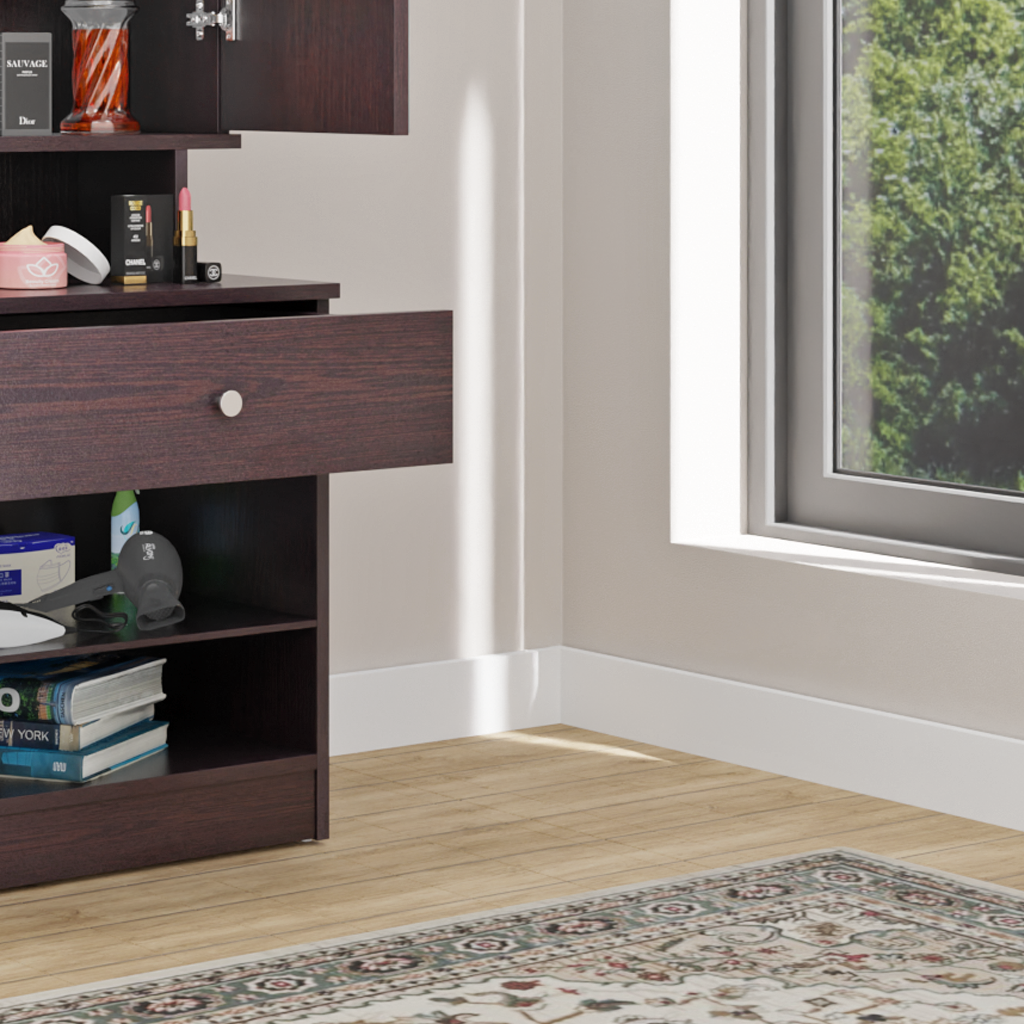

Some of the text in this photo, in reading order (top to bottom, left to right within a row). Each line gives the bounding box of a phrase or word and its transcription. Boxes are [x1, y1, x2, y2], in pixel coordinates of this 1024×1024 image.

[6, 60, 48, 68] SAUVAGE
[19, 116, 36, 125] Dior
[125, 258, 146, 266] CHANEL
[17, 729, 49, 742] YORK
